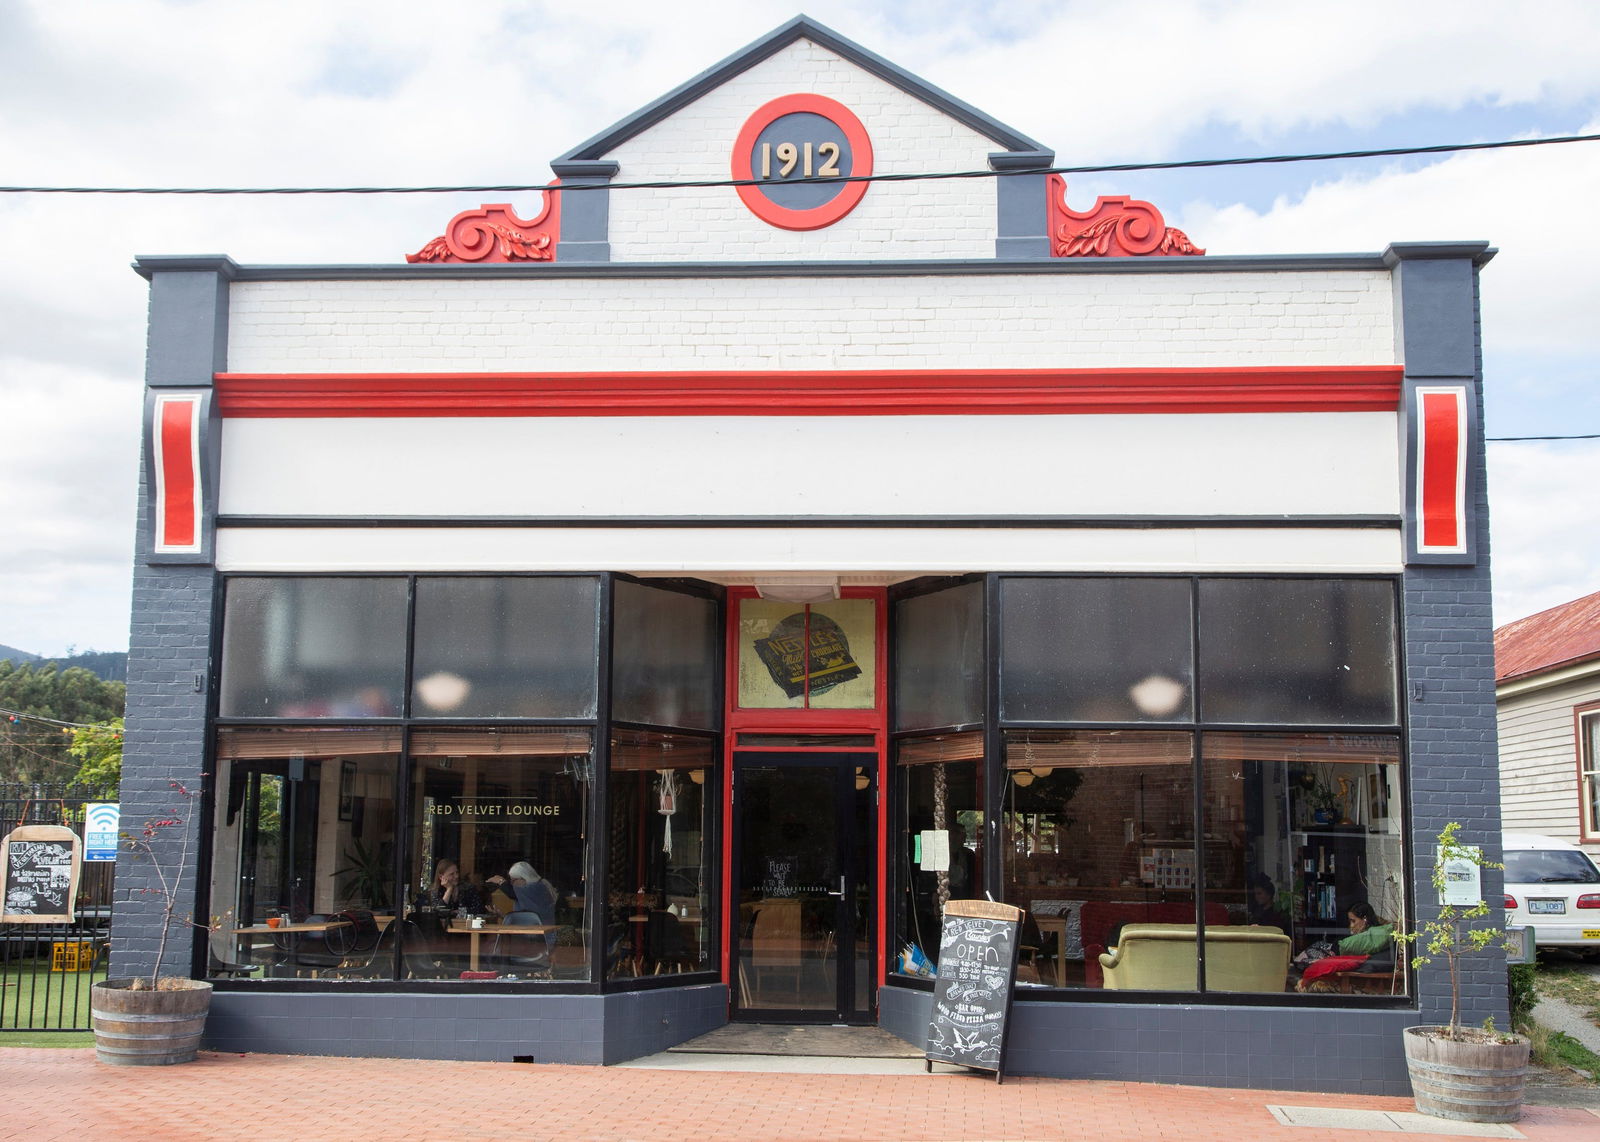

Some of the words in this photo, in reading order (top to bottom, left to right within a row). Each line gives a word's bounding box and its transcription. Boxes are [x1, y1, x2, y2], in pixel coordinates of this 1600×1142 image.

[762, 142, 840, 178] 1912
[429, 805, 453, 815] RED
[458, 805, 502, 815] VELVET
[506, 805, 560, 816] LOUNGE
[769, 861, 791, 872] PLEASE
[950, 927, 962, 936] RED
[964, 920, 986, 930] VELVET
[950, 1011, 965, 1023] FIRED
[966, 1015, 984, 1024] PIZZA
